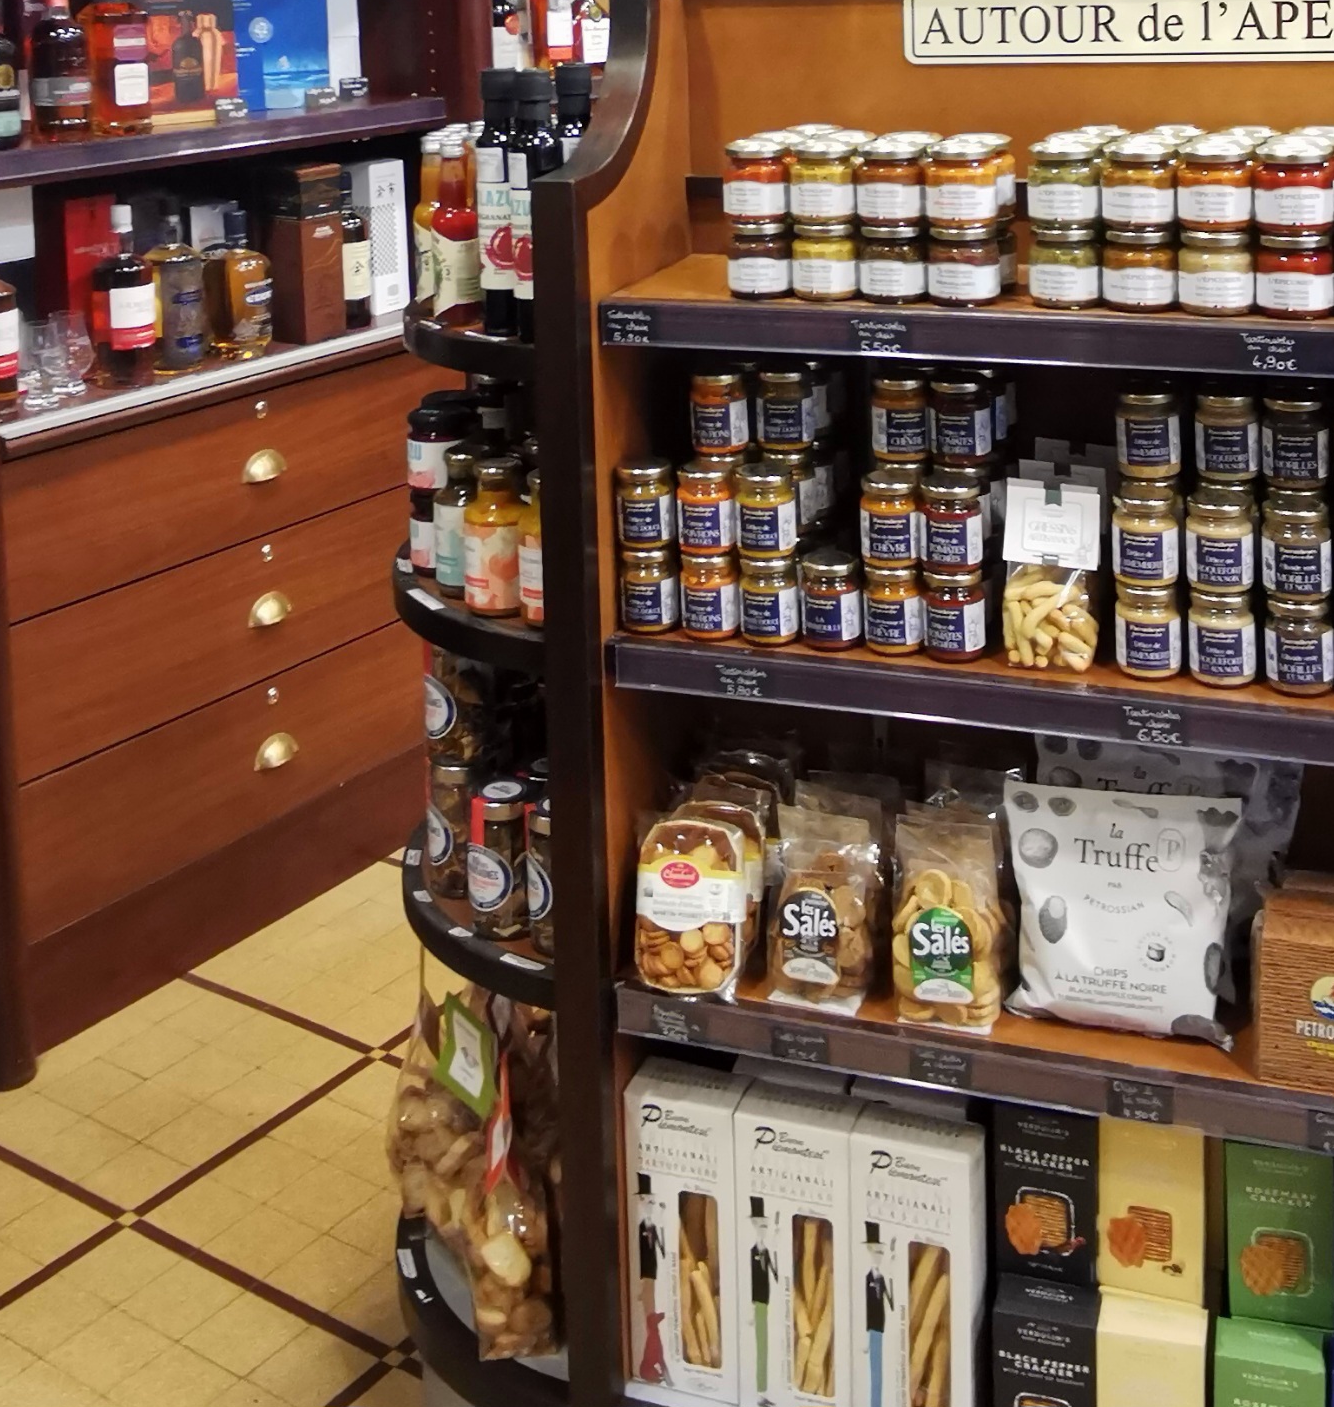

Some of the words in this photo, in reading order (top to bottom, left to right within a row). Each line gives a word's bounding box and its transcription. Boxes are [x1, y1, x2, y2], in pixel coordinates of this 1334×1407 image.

[920, 5, 1122, 45] AUTOUR
[1137, 3, 1184, 43] de
[1251, 354, 1298, 372] 4,90€
[1108, 822, 1124, 840] la
[1073, 837, 1160, 873] Truffe
[800, 899, 815, 916] les
[1082, 894, 1146, 914] PETROSSIAN
[782, 902, 838, 938] Salés
[912, 922, 971, 957] Salés
[1093, 965, 1129, 979] CHIPS
[1080, 975, 1128, 991] TRUFFE
[1129, 981, 1168, 995] NOIRE
[999, 1144, 1040, 1161] BLACK
[1042, 1151, 1091, 1167] PEPPER
[1014, 1154, 1074, 1172] CRACKER
[750, 1165, 835, 1189] ARTIGIANALI
[867, 1190, 953, 1216] ARTIGIANALI
[998, 1349, 1040, 1366] BLACK
[1042, 1357, 1091, 1374] PEPPER
[1014, 1359, 1074, 1379] CRACKER
